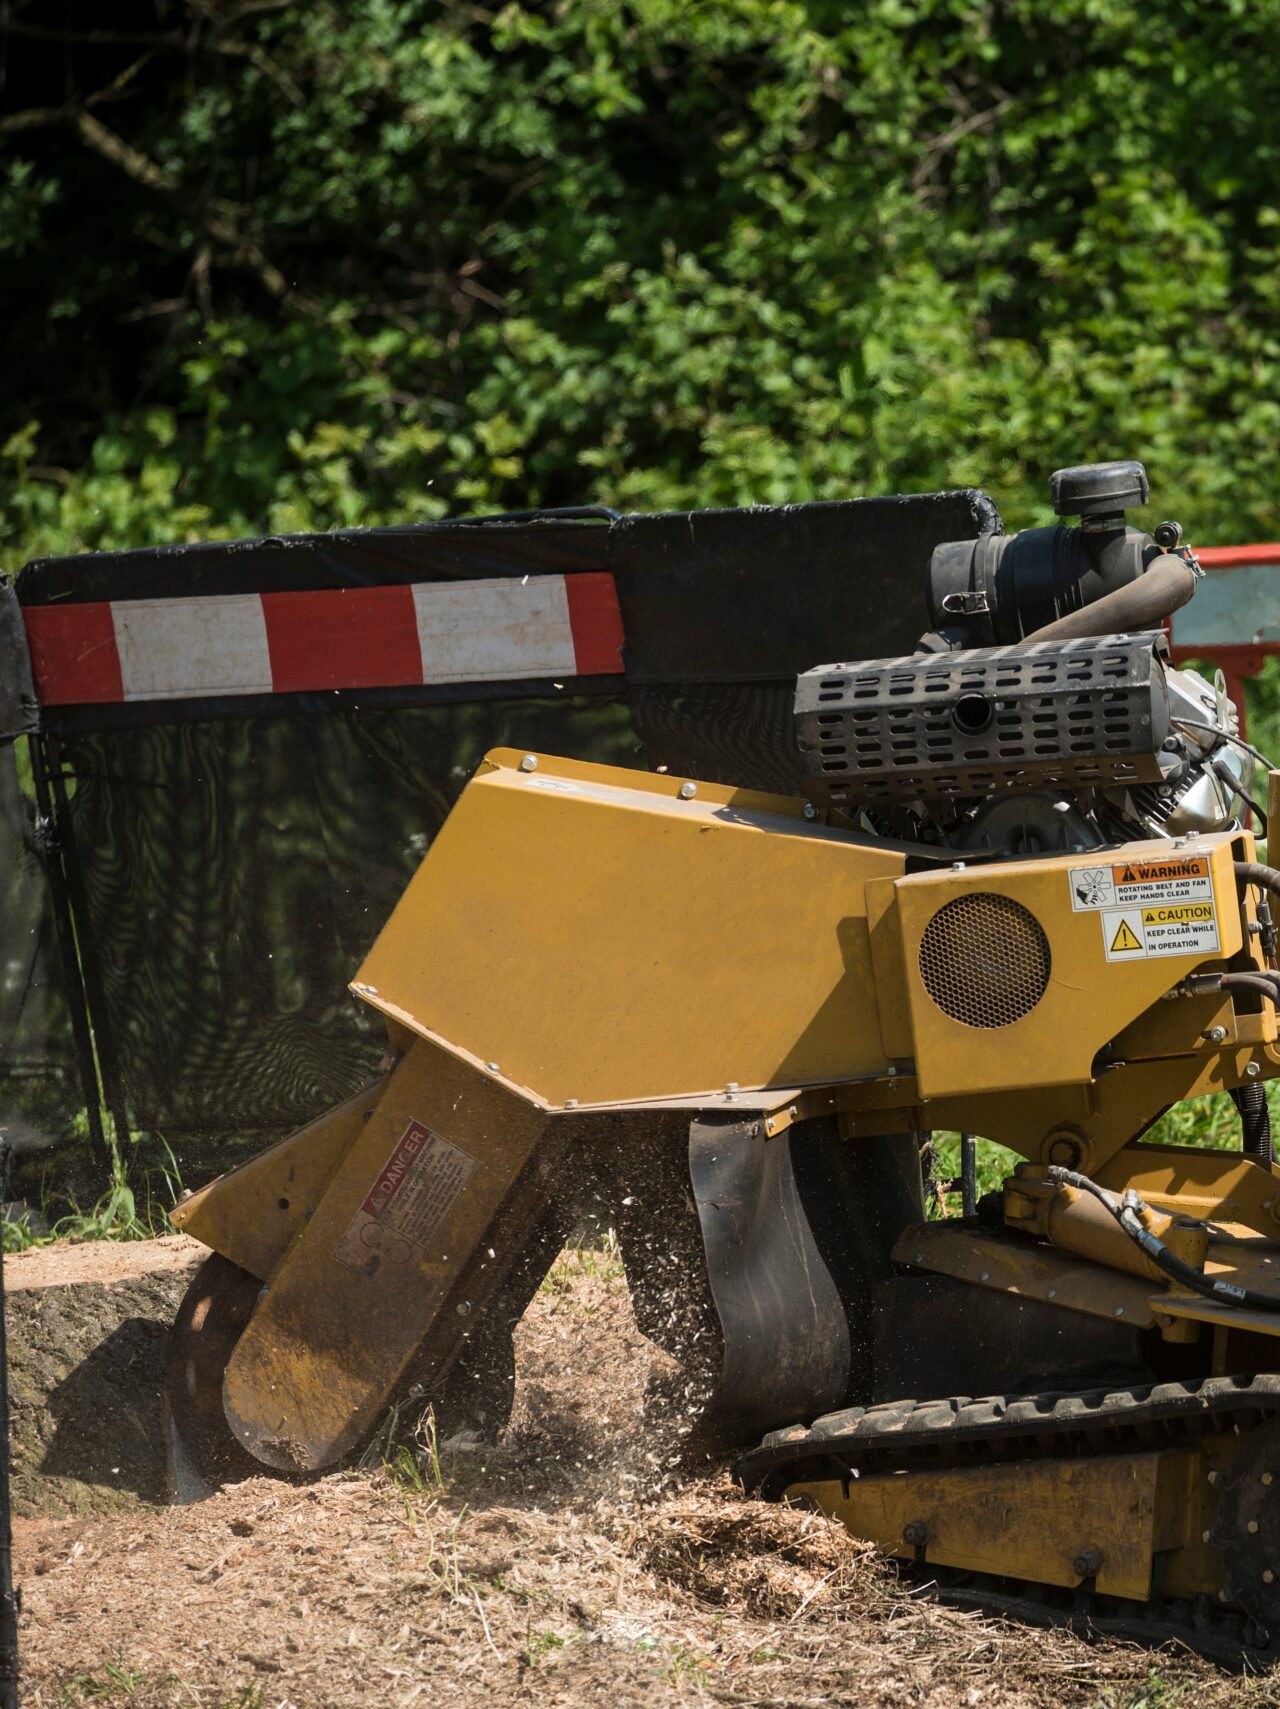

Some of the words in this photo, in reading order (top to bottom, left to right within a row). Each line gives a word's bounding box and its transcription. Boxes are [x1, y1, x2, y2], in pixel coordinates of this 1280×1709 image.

[1138, 864, 1200, 879] WARNING
[1118, 884, 1153, 893] ROTATING
[1156, 882, 1173, 890] BELT
[1119, 894, 1138, 902] KEEP
[1140, 892, 1164, 900] HANDS
[1167, 890, 1190, 898] CLEAR
[1158, 907, 1212, 920] CAUTION
[1147, 929, 1166, 937] KEEP
[1167, 926, 1191, 935] CLEAR
[1192, 925, 1214, 933] WHILE
[1158, 940, 1199, 950] OPERATION
[381, 1130, 424, 1194] DANGER
